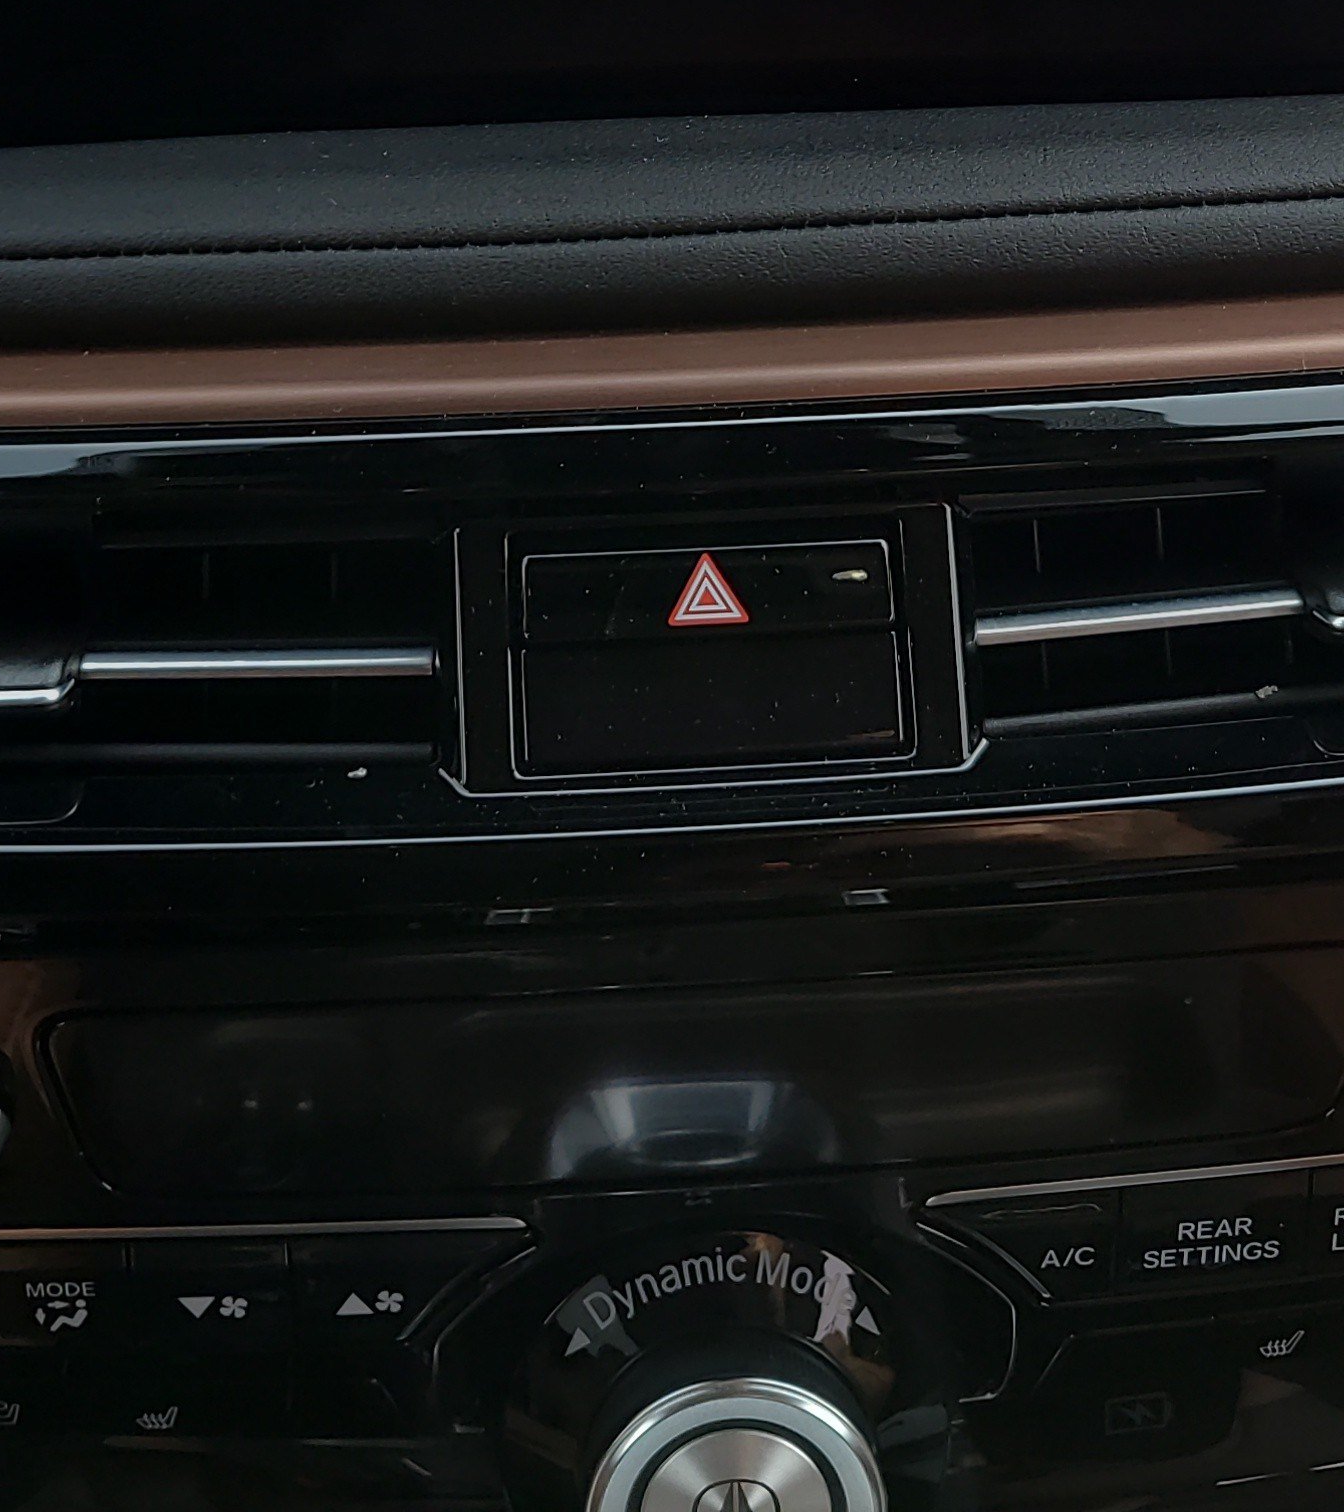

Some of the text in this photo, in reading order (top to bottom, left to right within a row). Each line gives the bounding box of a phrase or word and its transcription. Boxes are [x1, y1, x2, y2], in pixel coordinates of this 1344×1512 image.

[1178, 1218, 1253, 1241] REAR
[1041, 1247, 1094, 1268] A/C
[1143, 1240, 1280, 1268] SETTINGS
[26, 1282, 95, 1297] MODE
[582, 1246, 748, 1331] Dynamic
